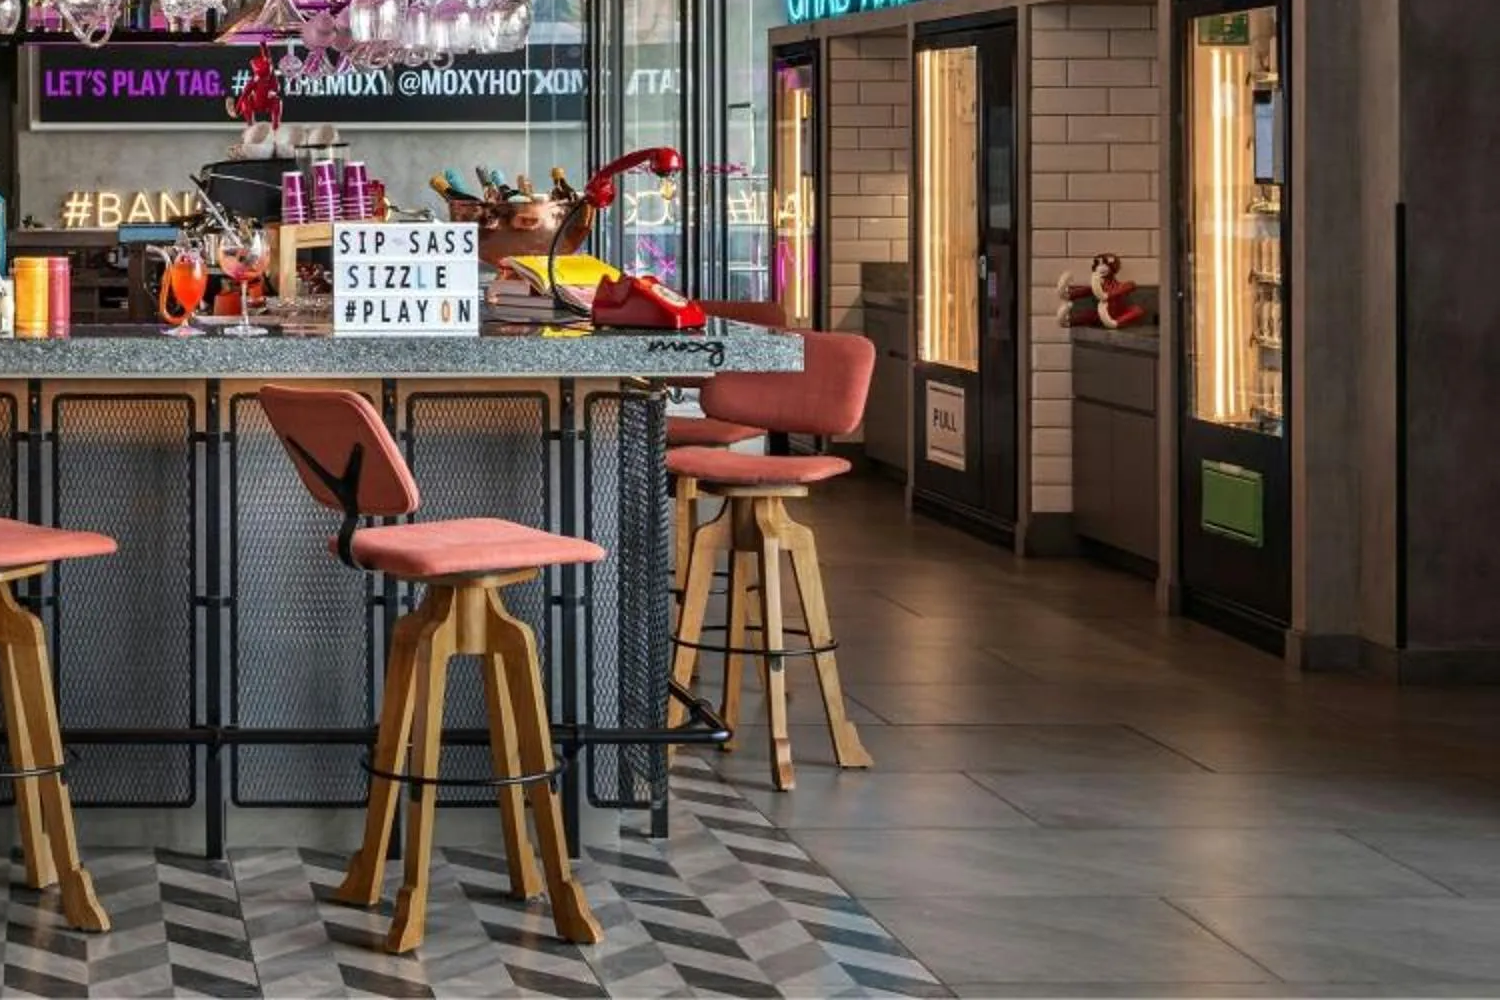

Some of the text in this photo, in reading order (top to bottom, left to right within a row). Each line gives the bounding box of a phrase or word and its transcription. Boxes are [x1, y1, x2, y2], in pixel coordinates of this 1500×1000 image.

[45, 69, 107, 97] LET'S
[112, 69, 170, 97] PLAY
[175, 69, 225, 97] TAG.
[339, 230, 474, 254] SIP SASS
[347, 264, 447, 289] SIZZLE
